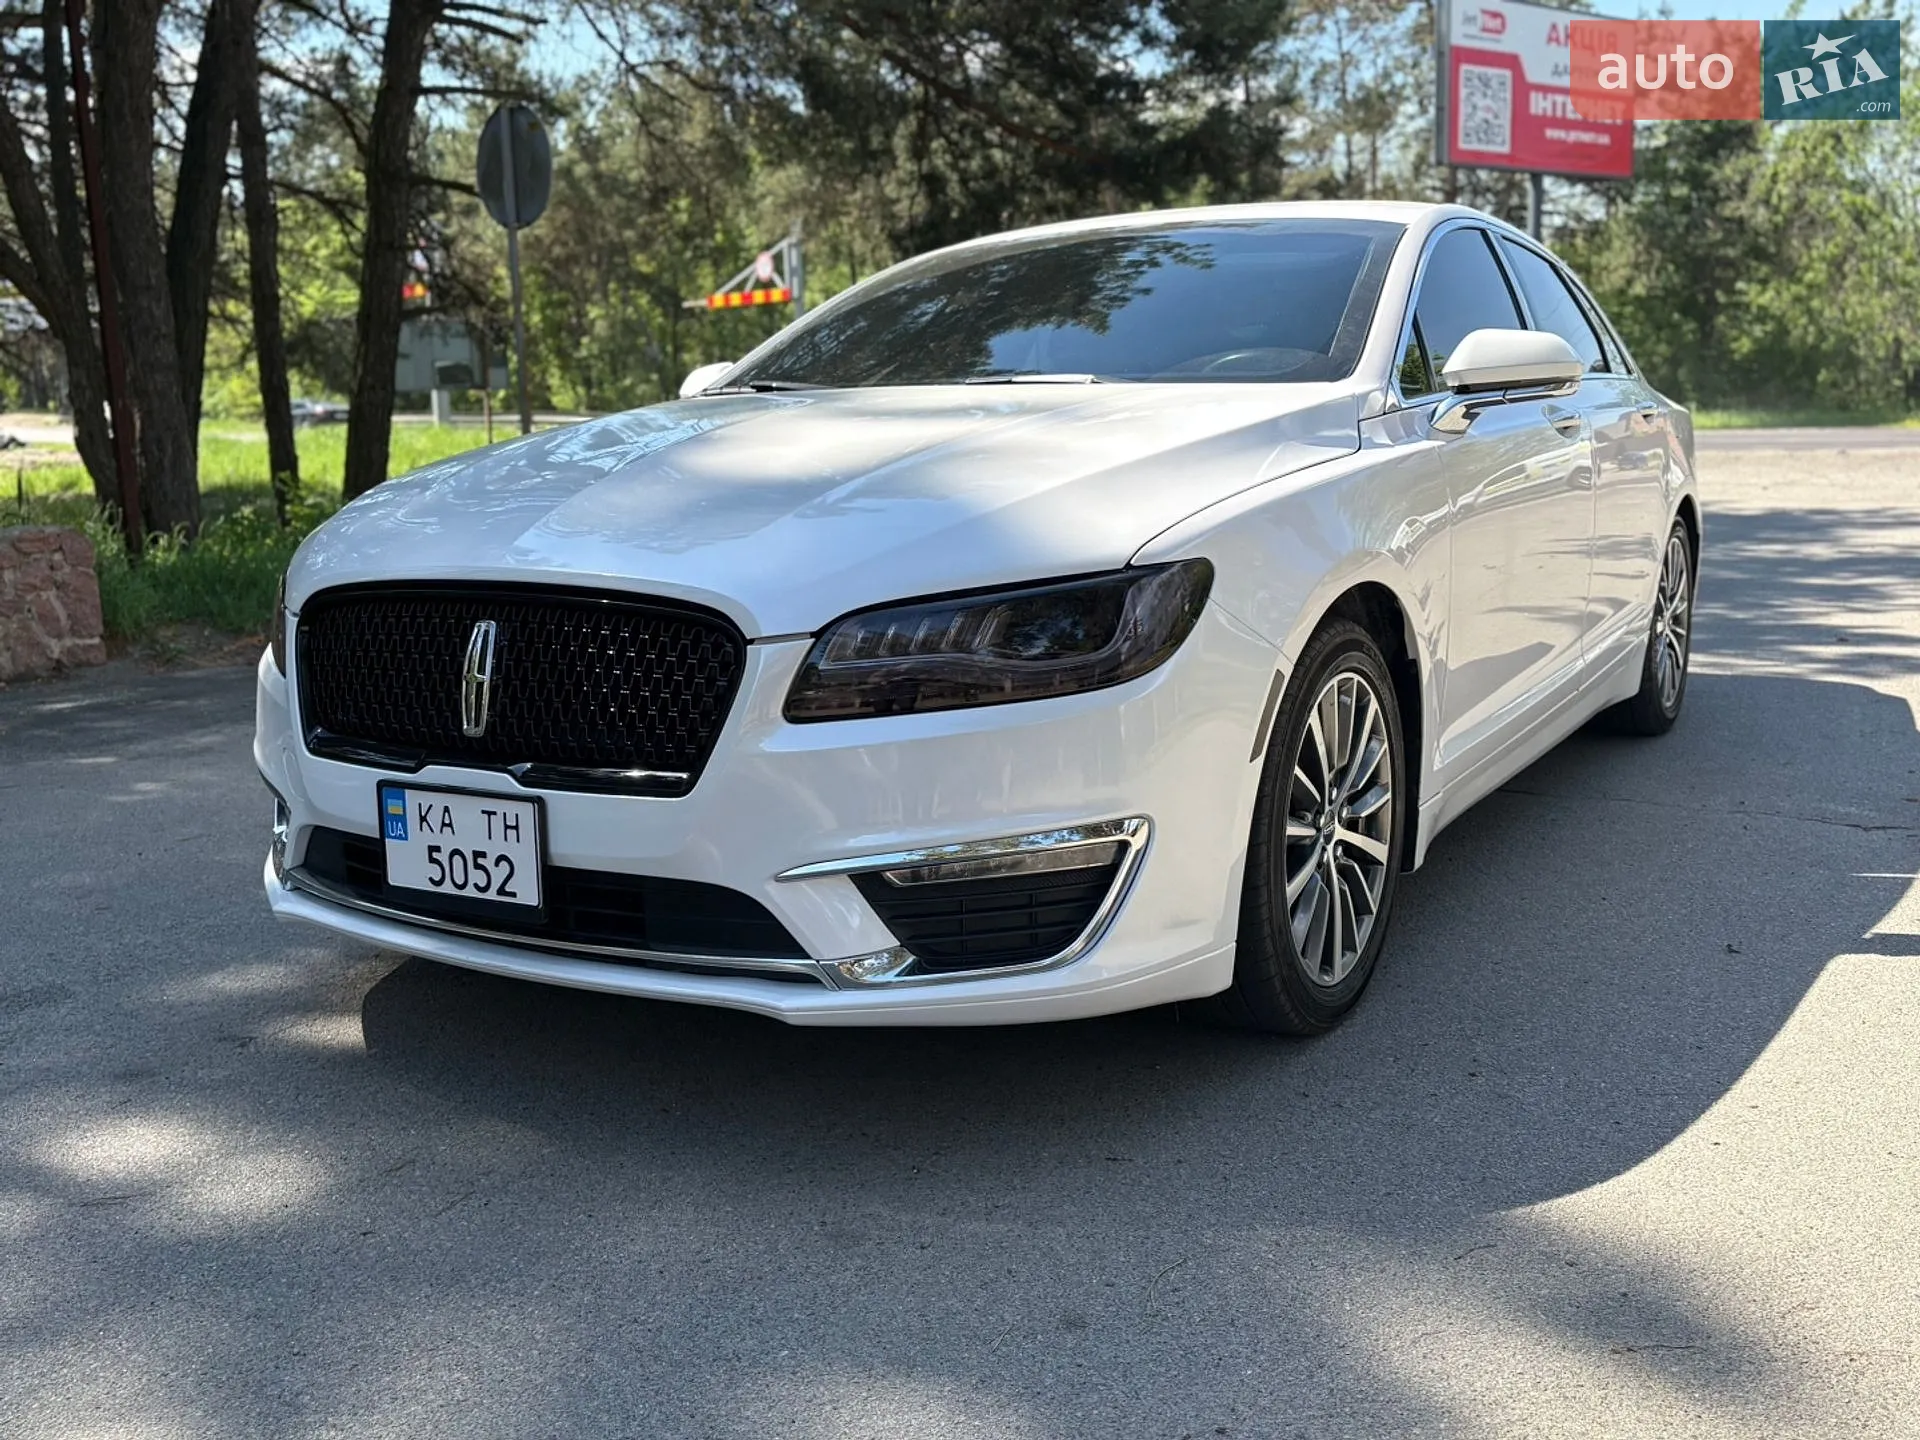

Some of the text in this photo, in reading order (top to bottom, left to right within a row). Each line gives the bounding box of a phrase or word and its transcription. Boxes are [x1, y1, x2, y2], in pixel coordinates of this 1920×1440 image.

[387, 821, 405, 837] UA
[418, 803, 520, 843] KA TH
[428, 845, 517, 898] 5052
